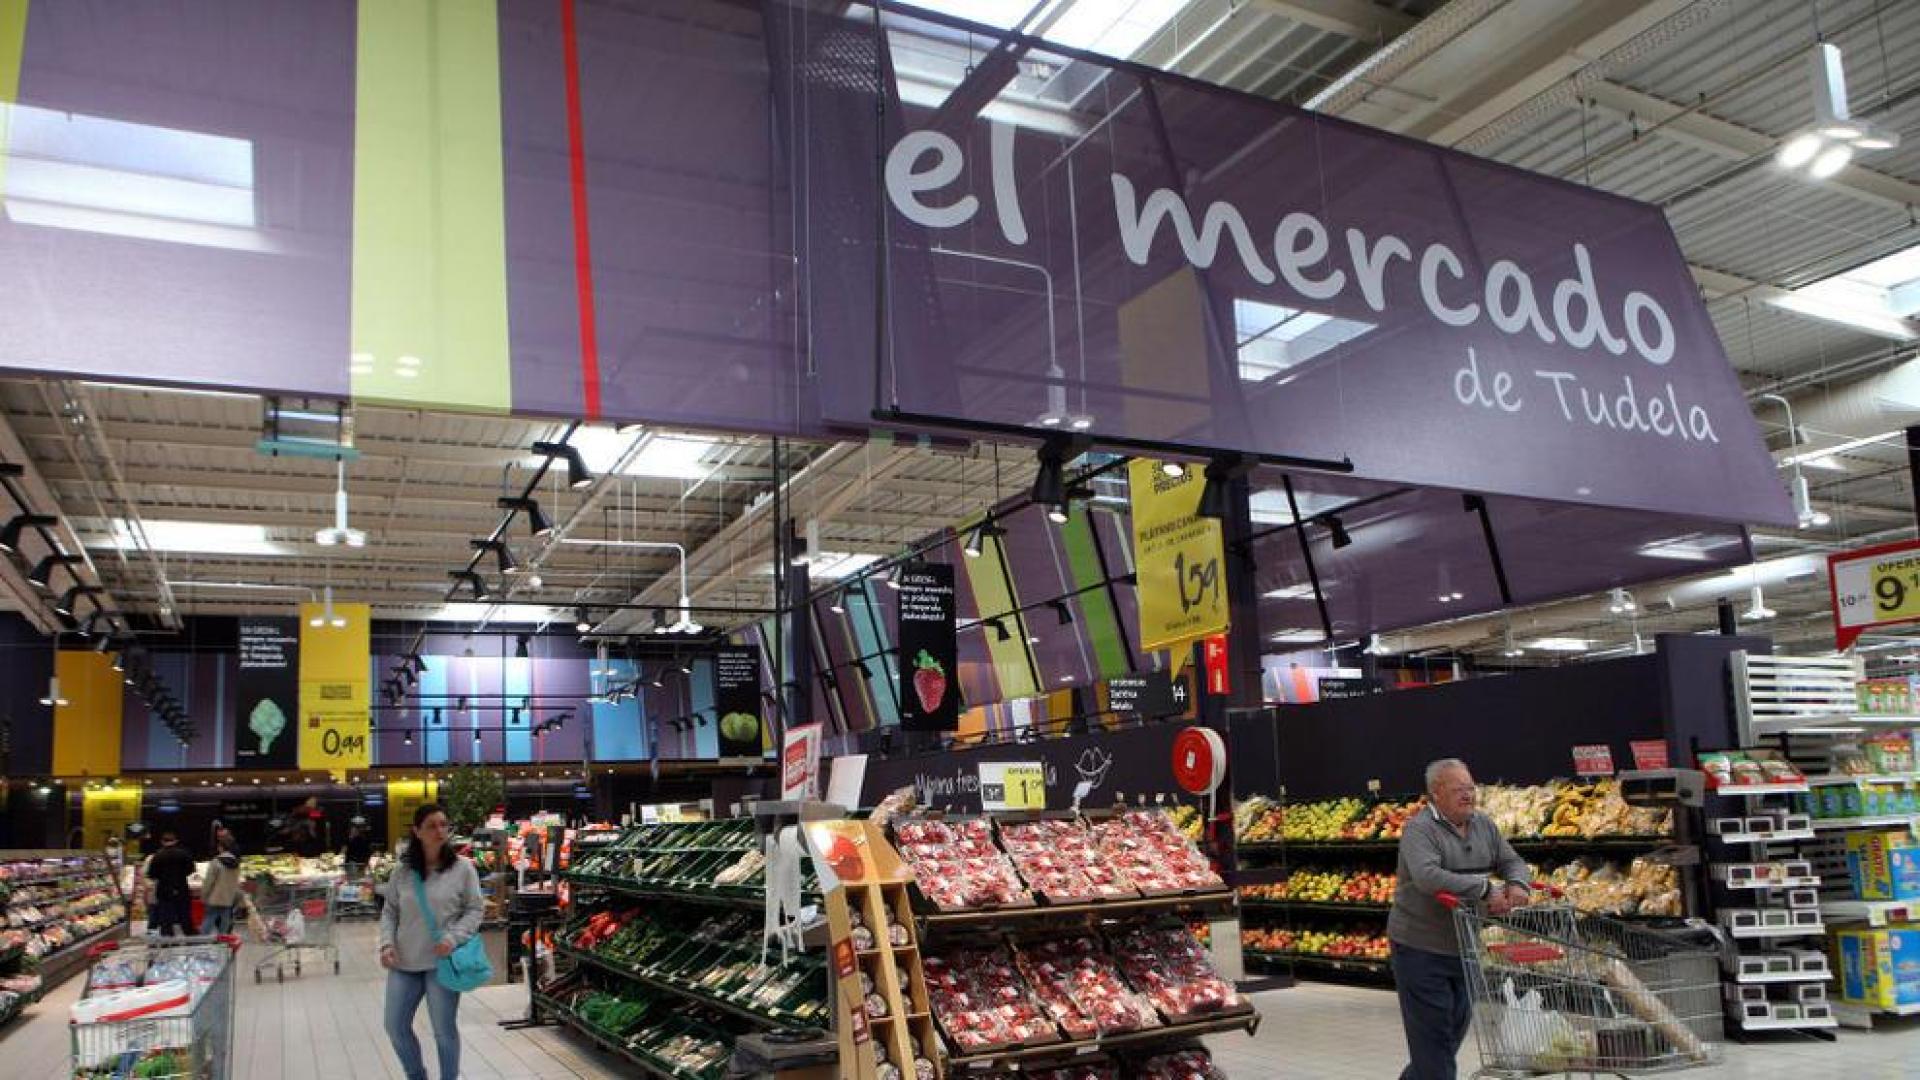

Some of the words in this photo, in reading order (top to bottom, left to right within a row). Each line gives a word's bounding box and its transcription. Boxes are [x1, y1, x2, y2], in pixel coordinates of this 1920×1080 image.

[885, 114, 1028, 245] el
[1111, 172, 1675, 365] mercado
[1455, 348, 1521, 412] de
[1535, 369, 1720, 443] Tudela
